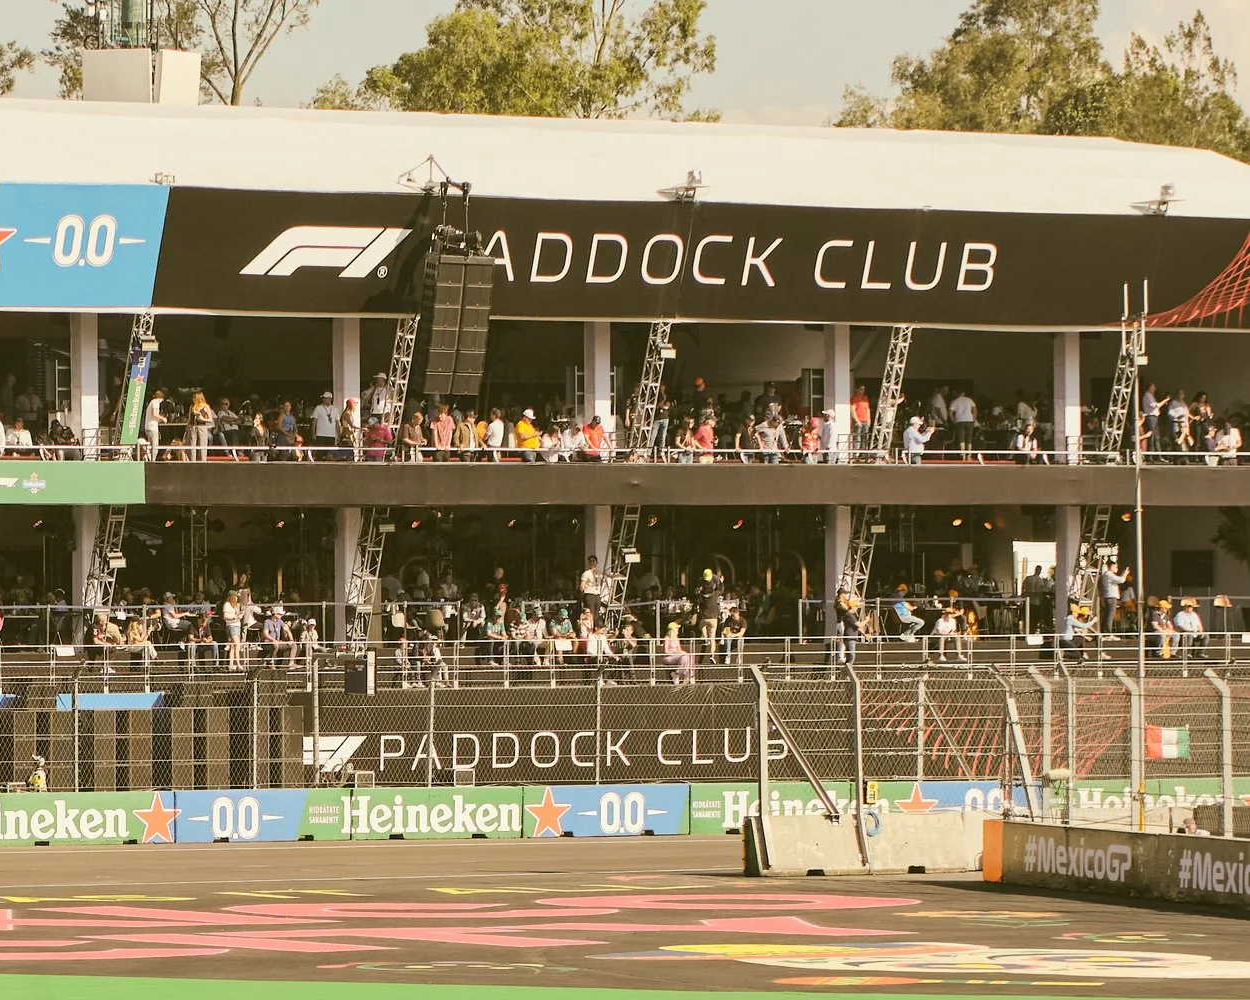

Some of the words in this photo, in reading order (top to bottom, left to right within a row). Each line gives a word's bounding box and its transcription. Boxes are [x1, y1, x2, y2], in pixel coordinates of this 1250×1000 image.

[52, 213, 119, 268] 0.0
[483, 230, 782, 288] ADDOCK
[814, 240, 998, 292] CLUB
[379, 730, 631, 772] PADDOCK
[211, 796, 260, 840] 0.0
[308, 804, 340, 814] HIDRÁTATE
[341, 794, 523, 834] Heineken
[599, 791, 645, 834] 0.0
[1024, 835, 1132, 882] #MexicoGP
[214, 888, 376, 899] IT
[426, 883, 716, 895] ALL
